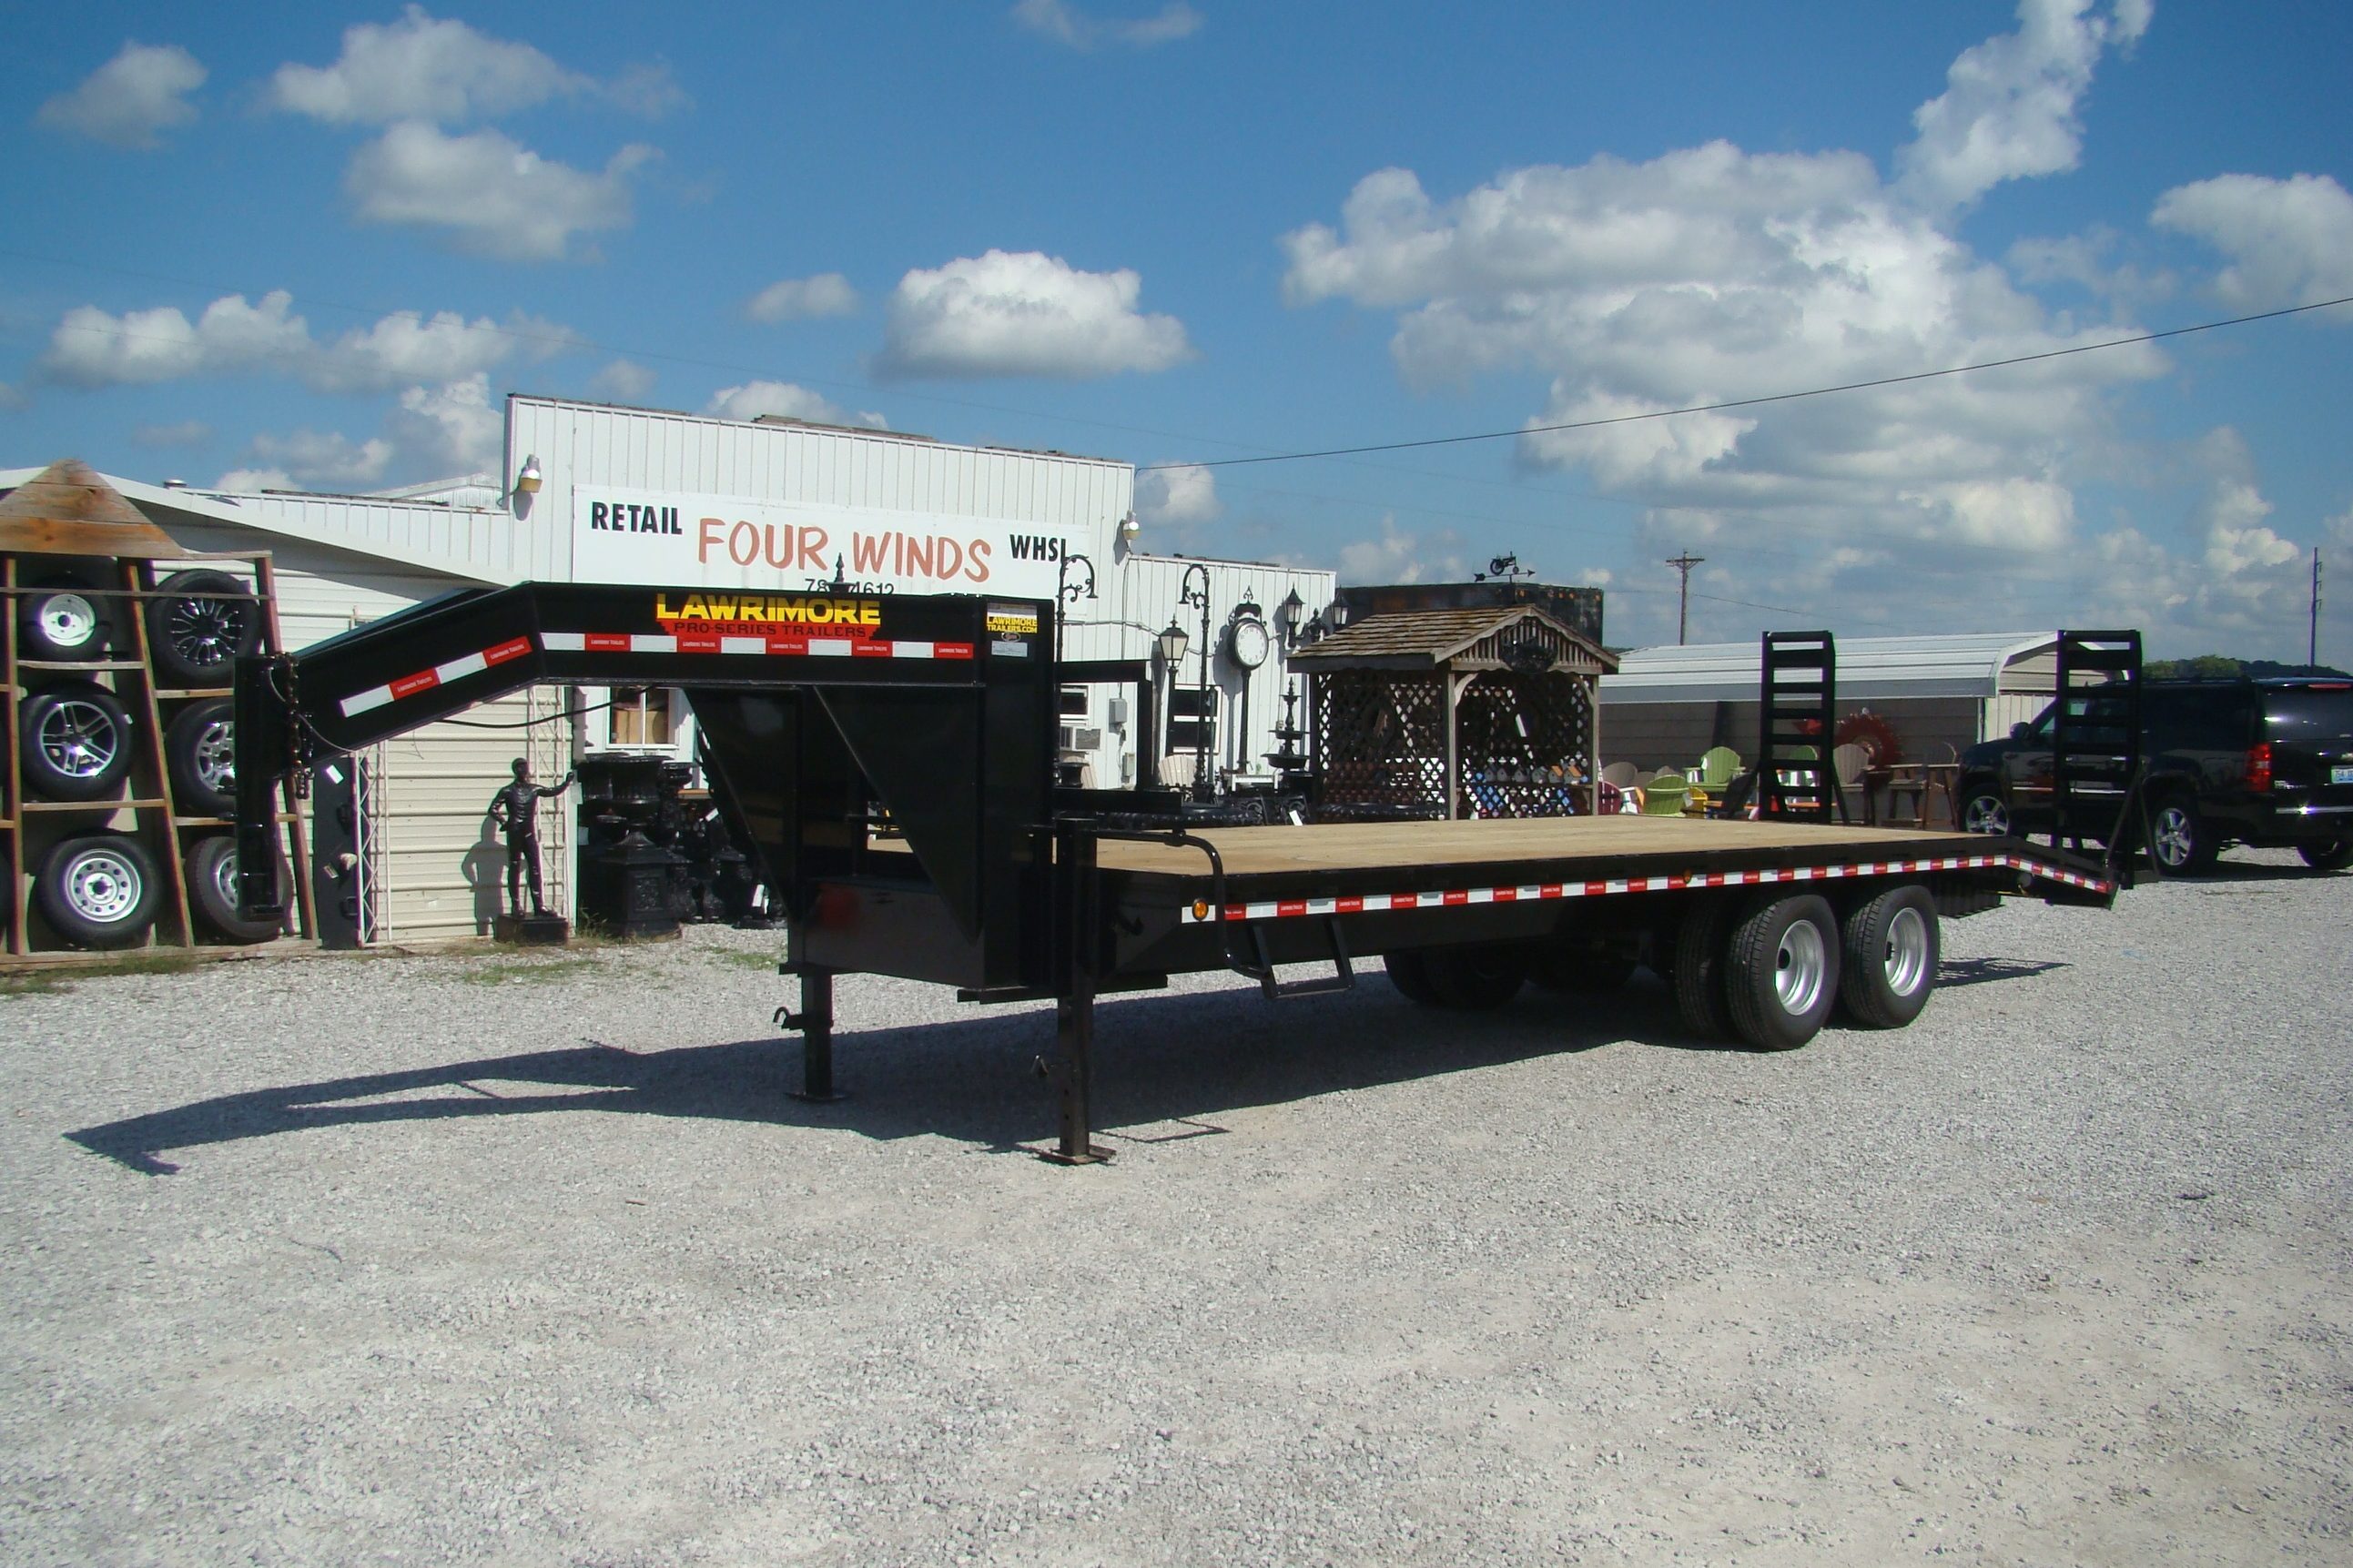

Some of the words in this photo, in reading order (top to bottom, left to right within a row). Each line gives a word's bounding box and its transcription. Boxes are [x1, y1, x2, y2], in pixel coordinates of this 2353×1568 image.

[591, 501, 683, 535] RETAIL
[698, 517, 828, 571] FOUR
[853, 531, 992, 582] WINDS
[656, 592, 881, 625] LAWRIMORE
[988, 616, 1038, 628] LAWRIMORE
[674, 622, 776, 636] PRO-SERIES
[783, 625, 866, 637] TRAILERS
